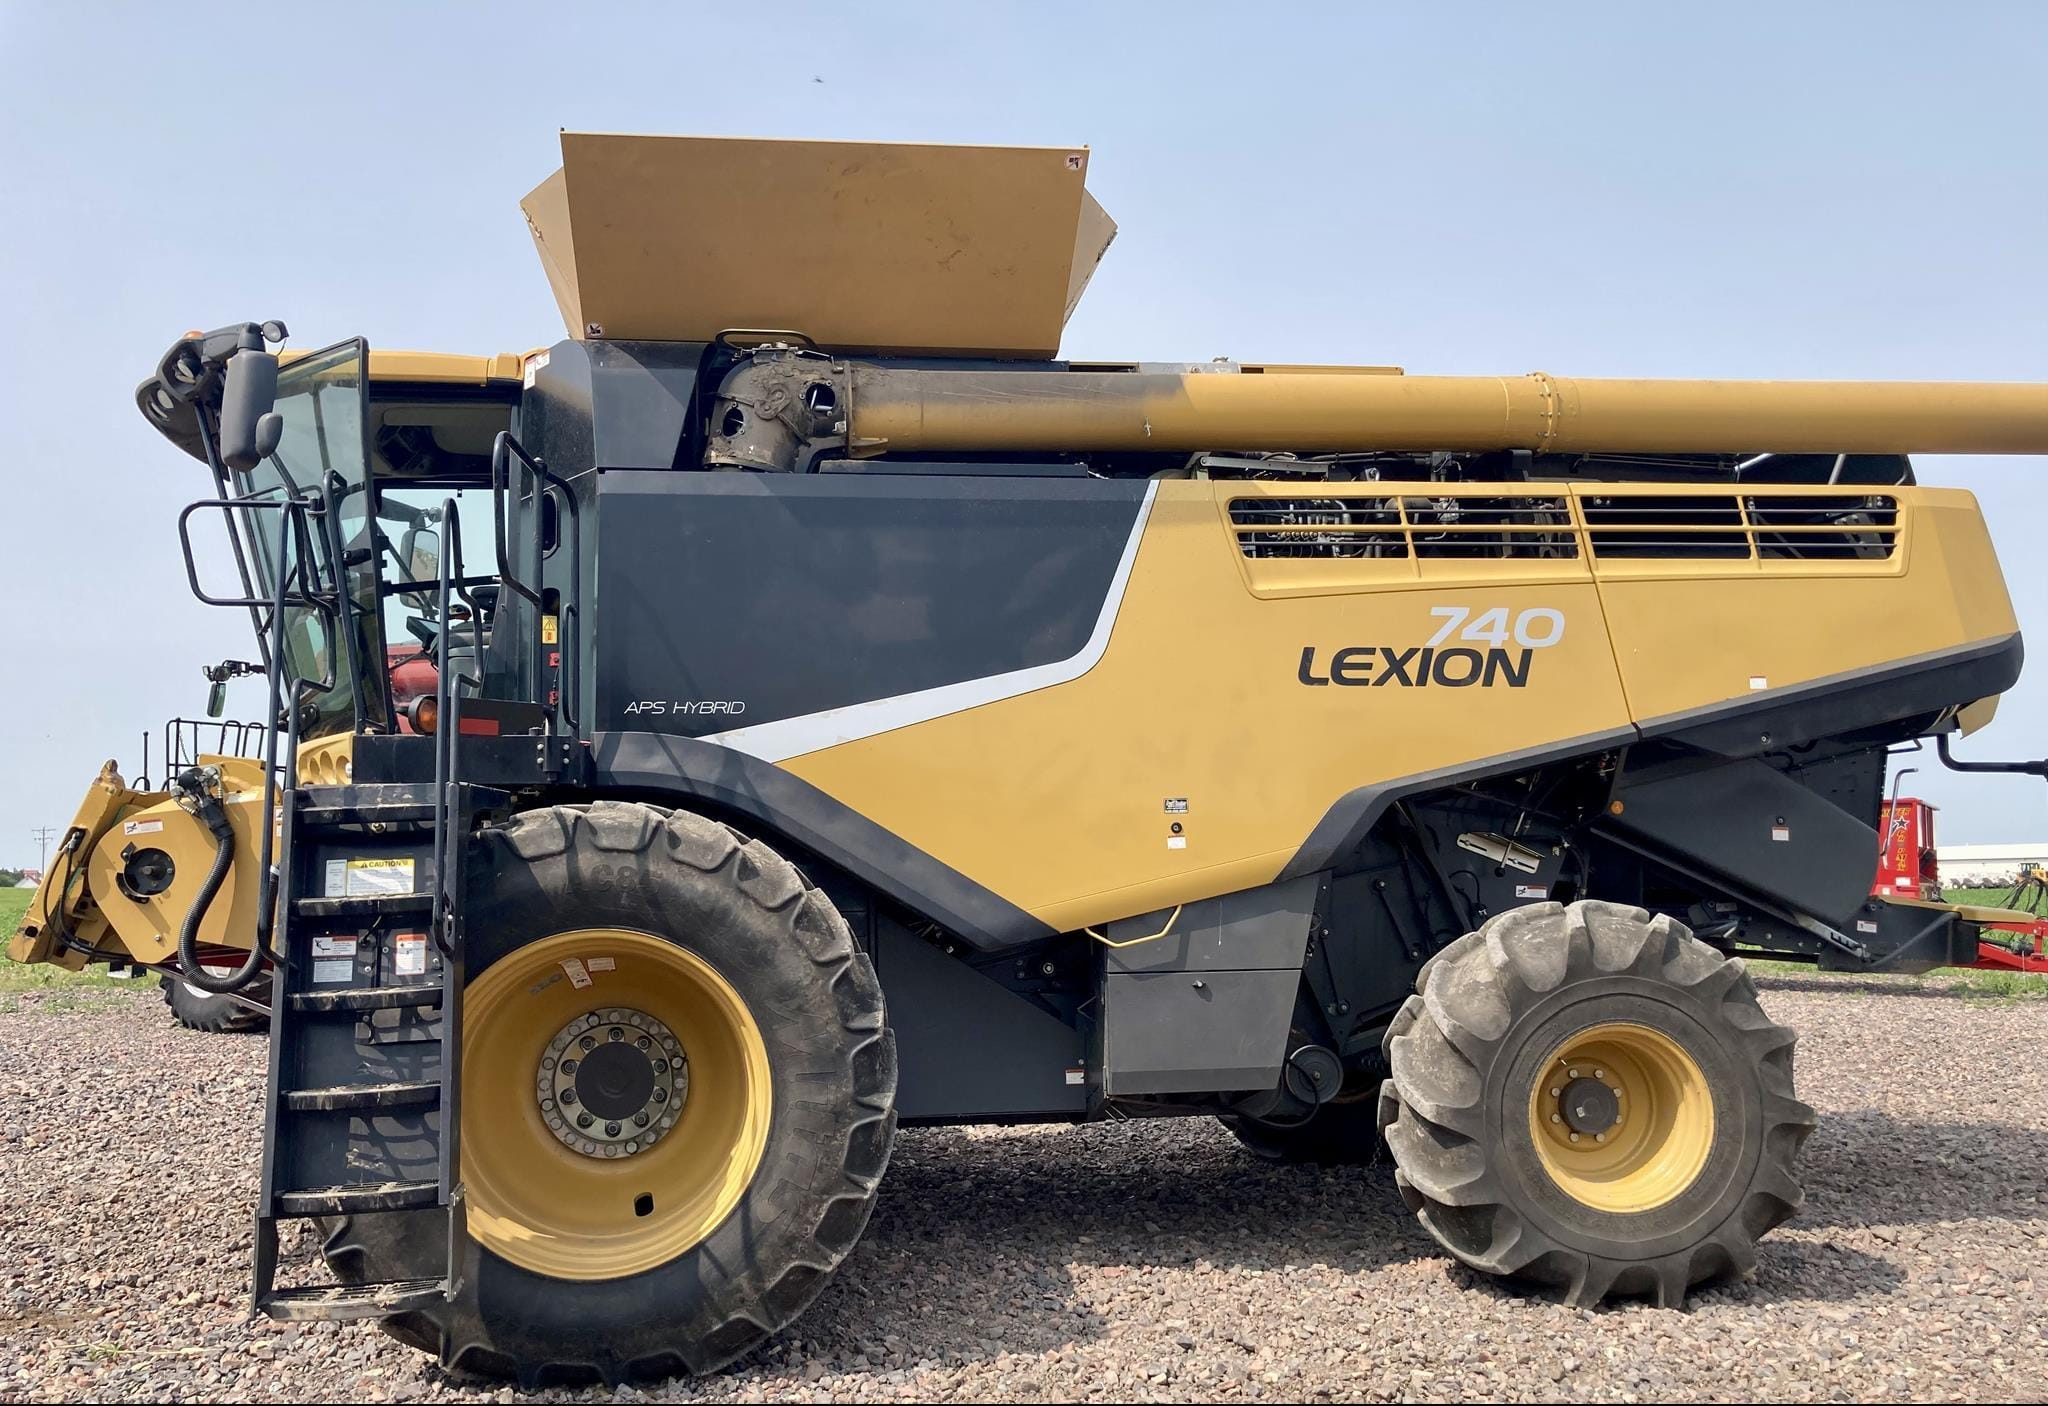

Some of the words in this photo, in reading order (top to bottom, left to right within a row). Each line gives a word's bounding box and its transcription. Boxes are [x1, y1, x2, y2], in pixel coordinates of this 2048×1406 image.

[1425, 607, 1565, 648] 740
[1298, 647, 1533, 687] LEXION
[624, 701, 667, 714] APS
[672, 701, 746, 714] HYBRID
